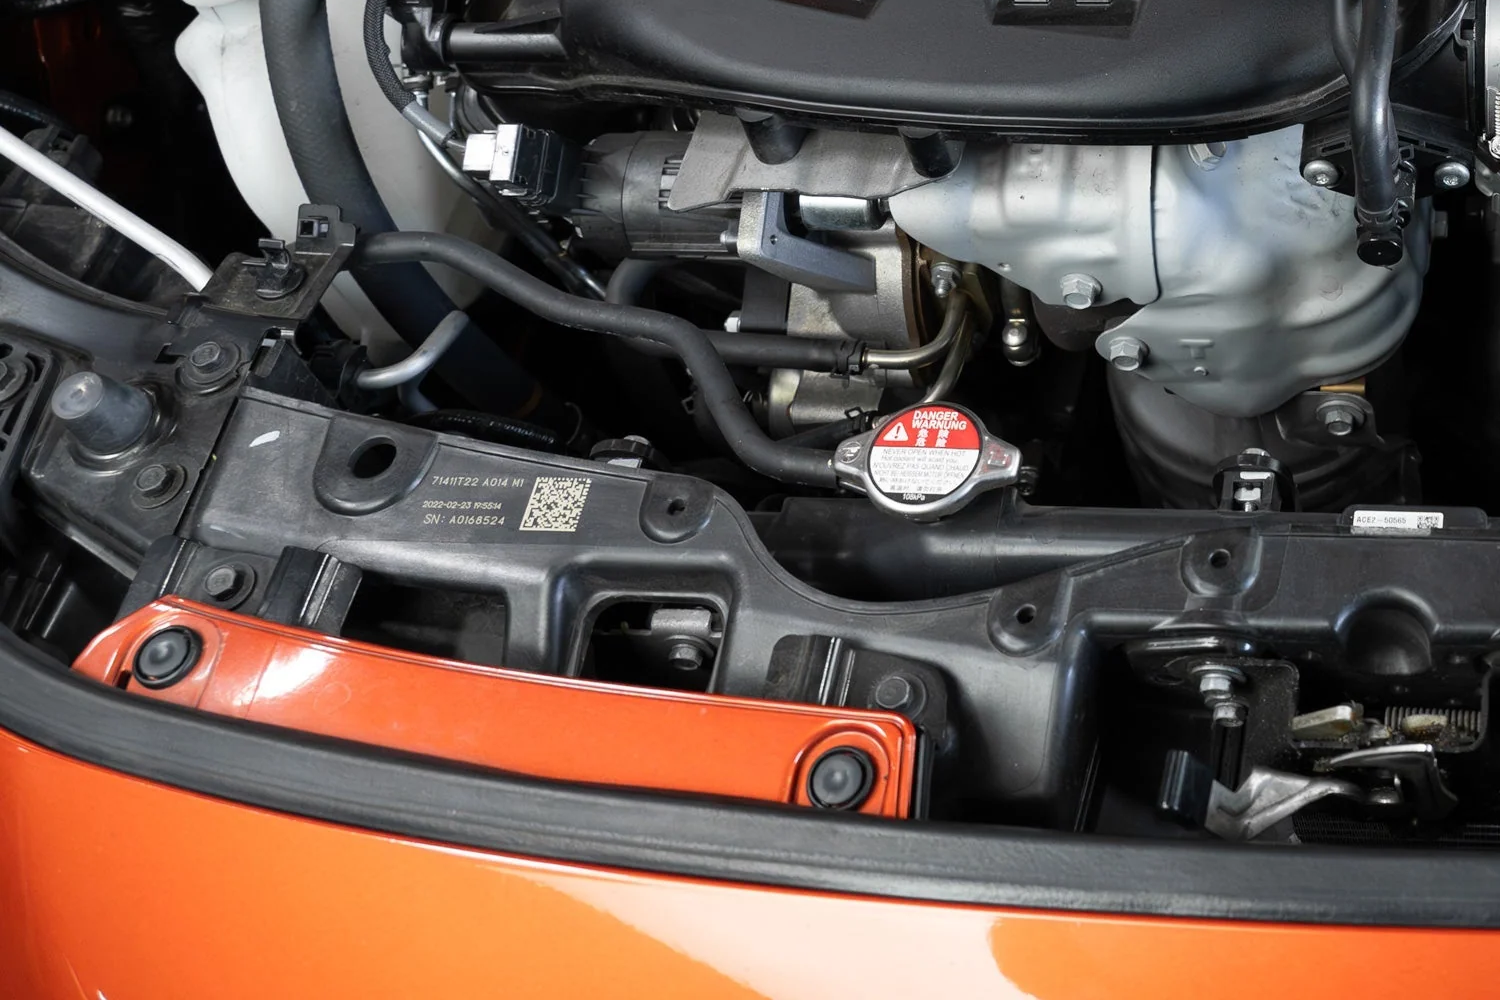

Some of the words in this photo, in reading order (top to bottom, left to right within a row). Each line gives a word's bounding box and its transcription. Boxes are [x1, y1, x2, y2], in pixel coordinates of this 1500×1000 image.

[913, 410, 959, 420] DANGER
[911, 419, 967, 430] WARNUNG
[431, 476, 479, 487] 71411T22
[482, 476, 508, 487] A014
[512, 477, 525, 487] M1
[422, 500, 472, 509] 2022-02-23
[423, 513, 446, 525] SN:
[449, 515, 505, 526] A0168524
